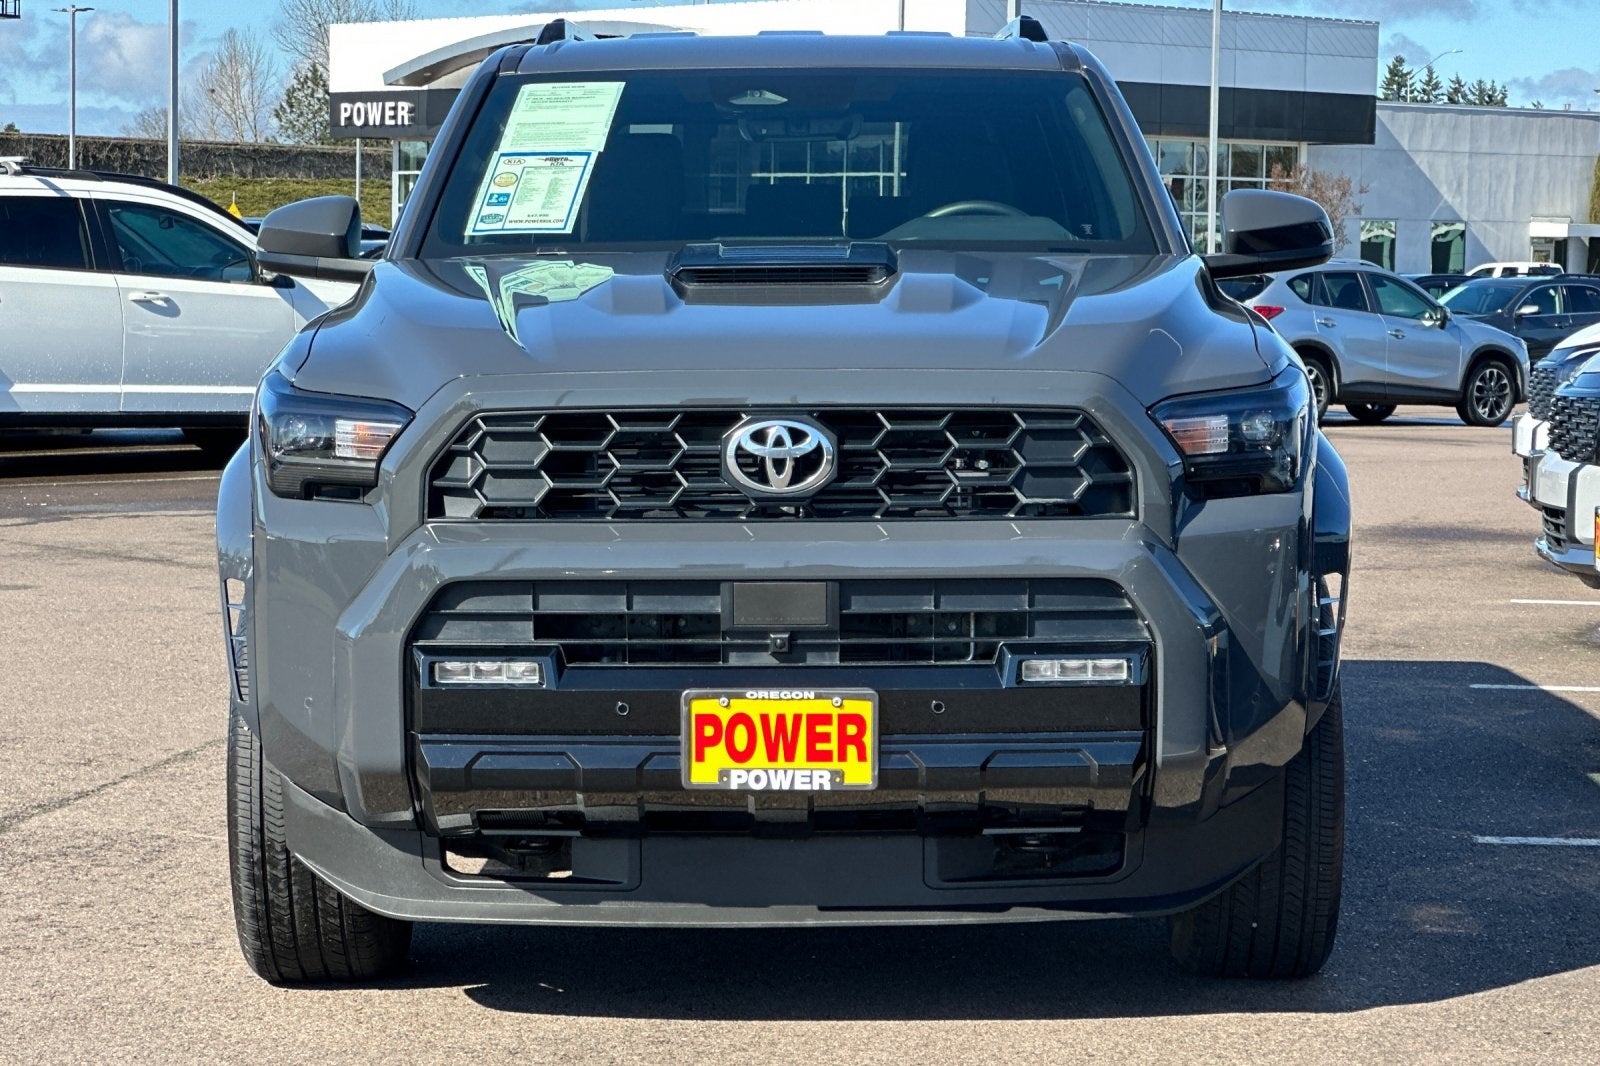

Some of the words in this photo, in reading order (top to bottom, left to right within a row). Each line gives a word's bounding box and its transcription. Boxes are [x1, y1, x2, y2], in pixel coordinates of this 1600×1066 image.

[340, 101, 411, 127] POWER
[745, 691, 815, 700] OREGON
[694, 712, 867, 764] POWER
[730, 769, 832, 790] POWER
